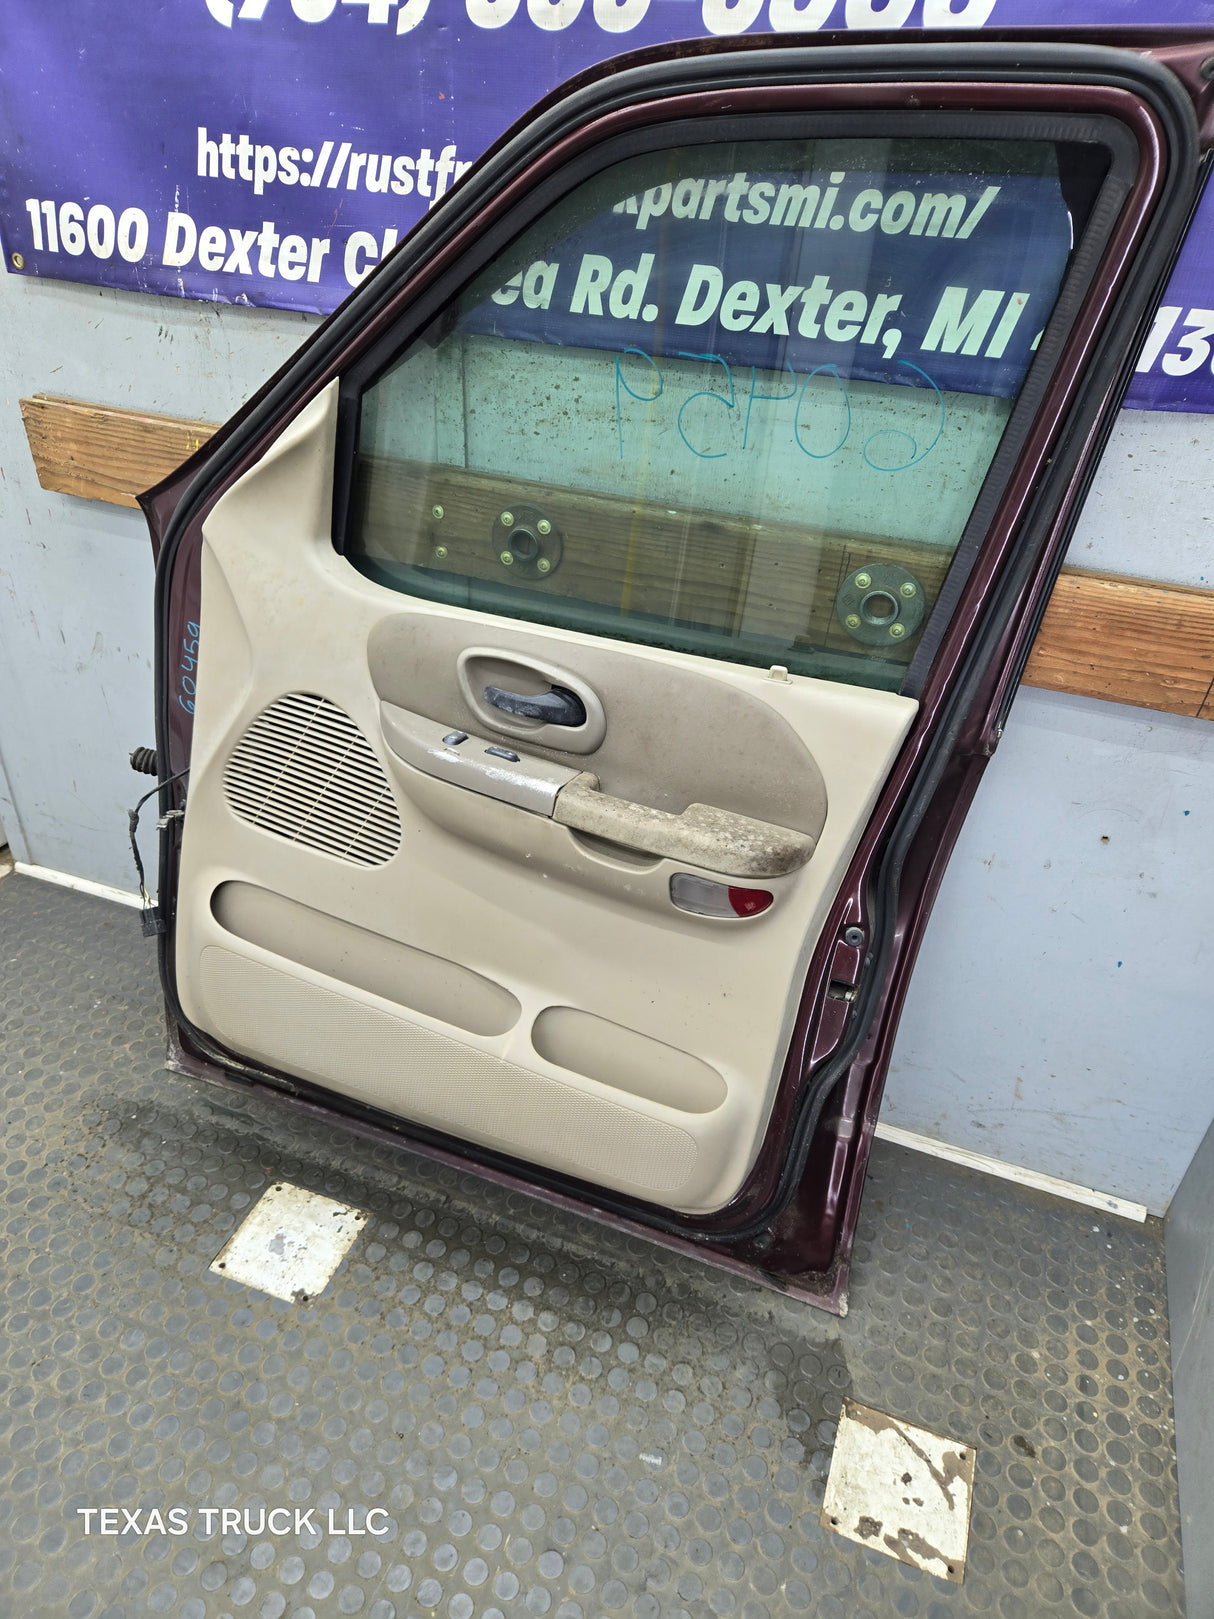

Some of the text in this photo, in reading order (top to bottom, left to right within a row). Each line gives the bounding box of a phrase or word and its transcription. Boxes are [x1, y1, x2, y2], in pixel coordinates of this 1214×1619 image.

[25, 198, 149, 263] 11600
[162, 211, 330, 284] Dexter
[569, 252, 659, 322] Rd.
[674, 263, 903, 359] Dexter,
[919, 286, 1030, 358] MI
[1134, 305, 1214, 377] 13
